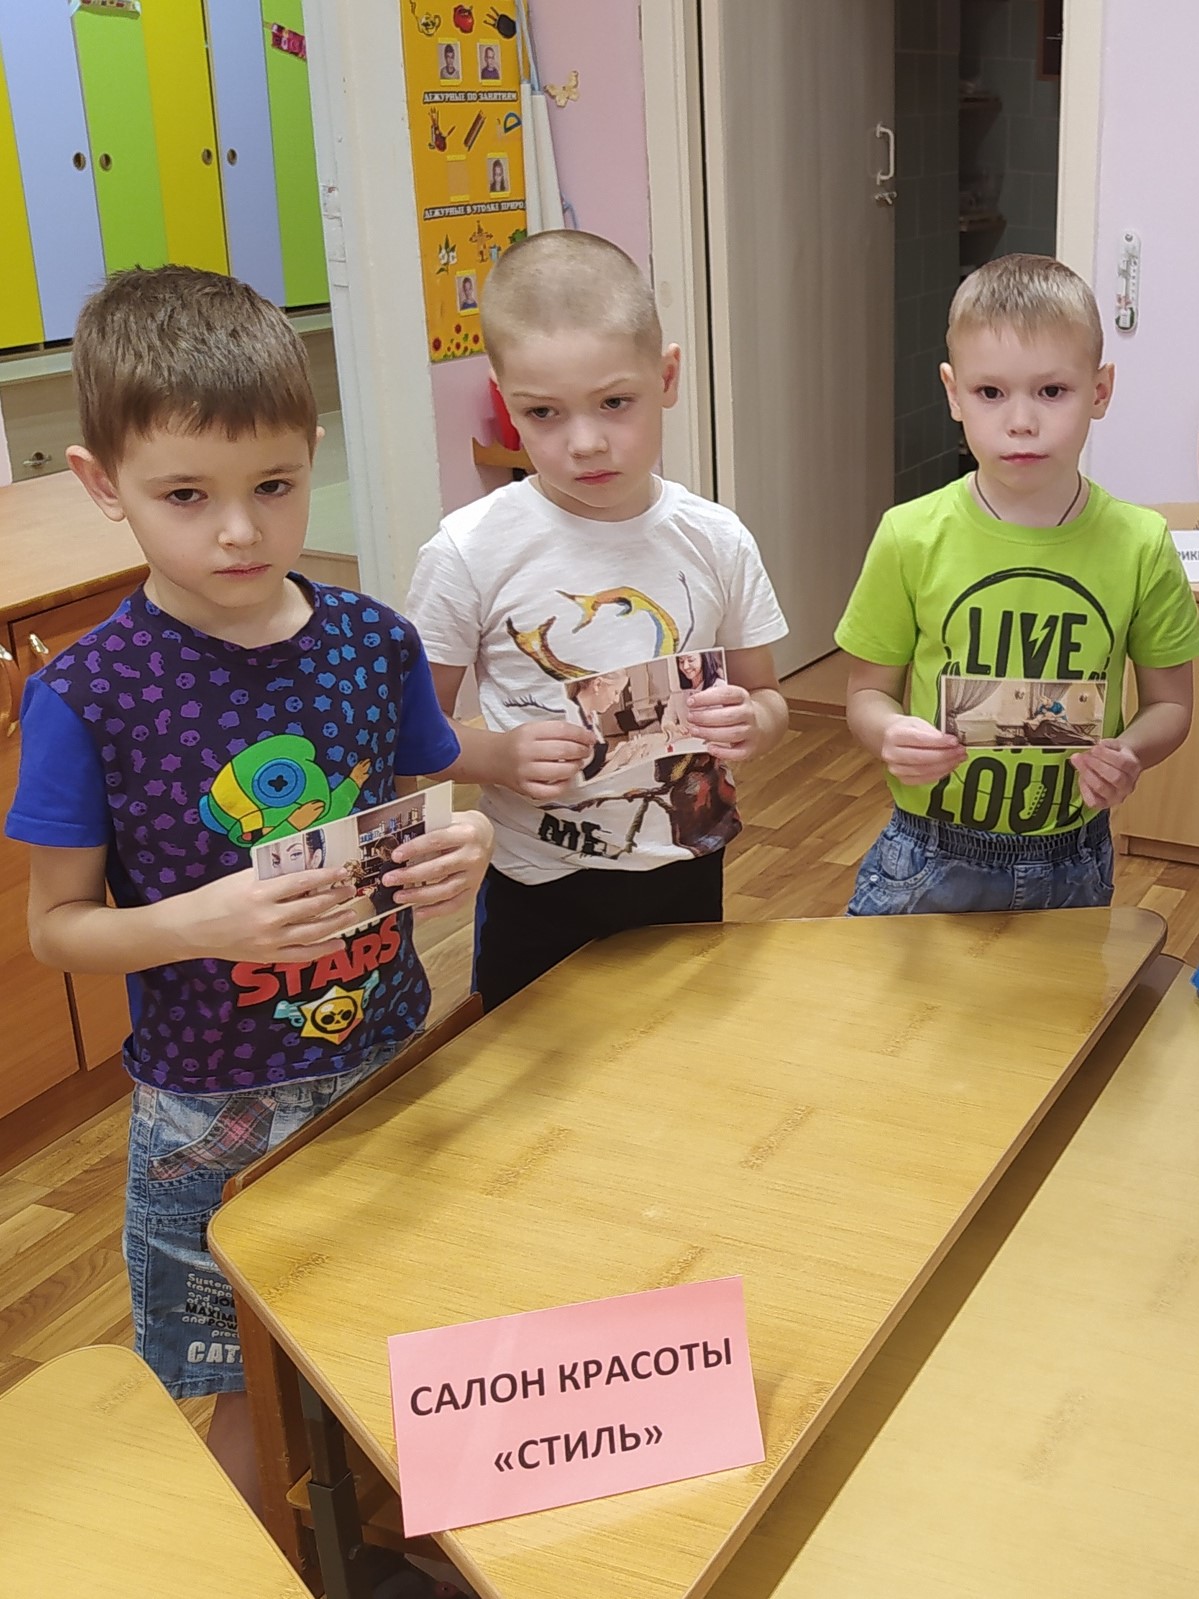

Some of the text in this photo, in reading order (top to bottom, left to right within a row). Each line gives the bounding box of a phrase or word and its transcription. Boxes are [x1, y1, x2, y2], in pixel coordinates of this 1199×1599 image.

[501, 201, 525, 210] ПРИРО
[966, 606, 1087, 679] LIVE
[231, 914, 400, 1008] STARS
[187, 1340, 244, 1364] CAT
[410, 1337, 732, 1417] САЛОН КРАСОТЫ
[493, 1423, 663, 1474] «СТИЛЬ»
